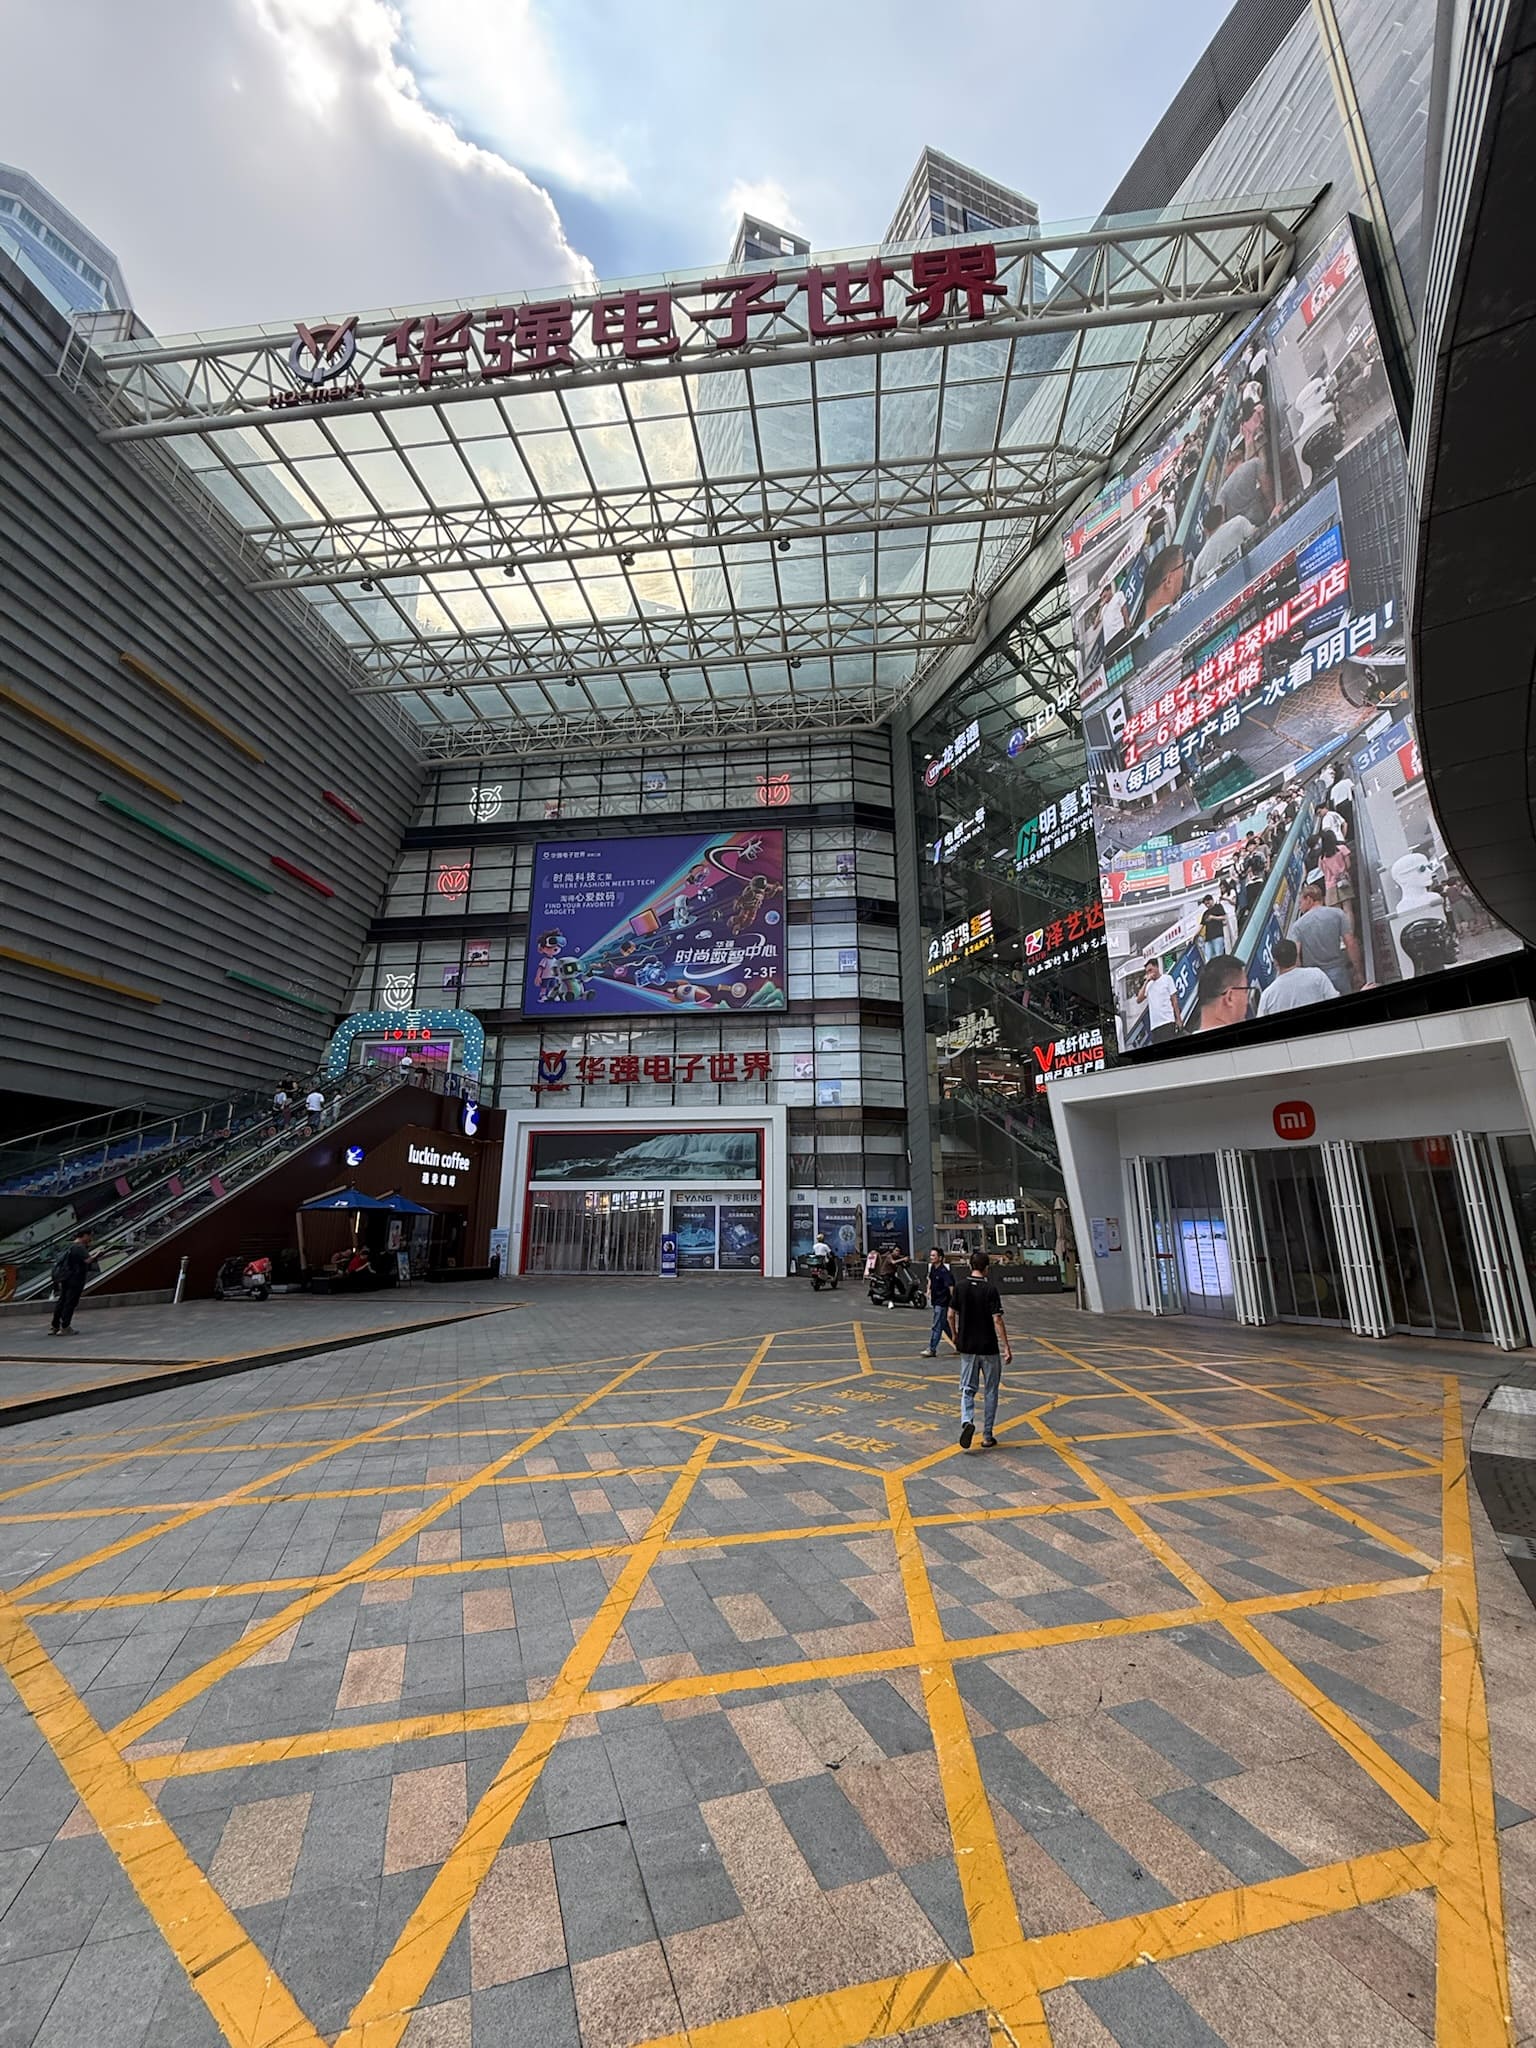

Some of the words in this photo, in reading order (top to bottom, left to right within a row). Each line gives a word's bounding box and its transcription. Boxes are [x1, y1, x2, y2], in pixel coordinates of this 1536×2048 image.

[381, 244, 1007, 387] 华强电子世界
[1122, 561, 1349, 743] 华强电子世界深圳二店
[1358, 742, 1382, 770] 3F
[944, 807, 986, 847] 电感一号
[553, 872, 613, 882] 时尚科技汇聚
[744, 966, 777, 979] 2-3F
[1176, 964, 1189, 998] 3F
[975, 1028, 1000, 1048] 2-3F
[576, 1052, 772, 1085] 华强电子世界
[408, 1144, 440, 1168] luckin
[441, 1151, 470, 1172] coffee
[676, 1193, 713, 1203] EYANG
[968, 1199, 1016, 1217] 书亦烧仙草
